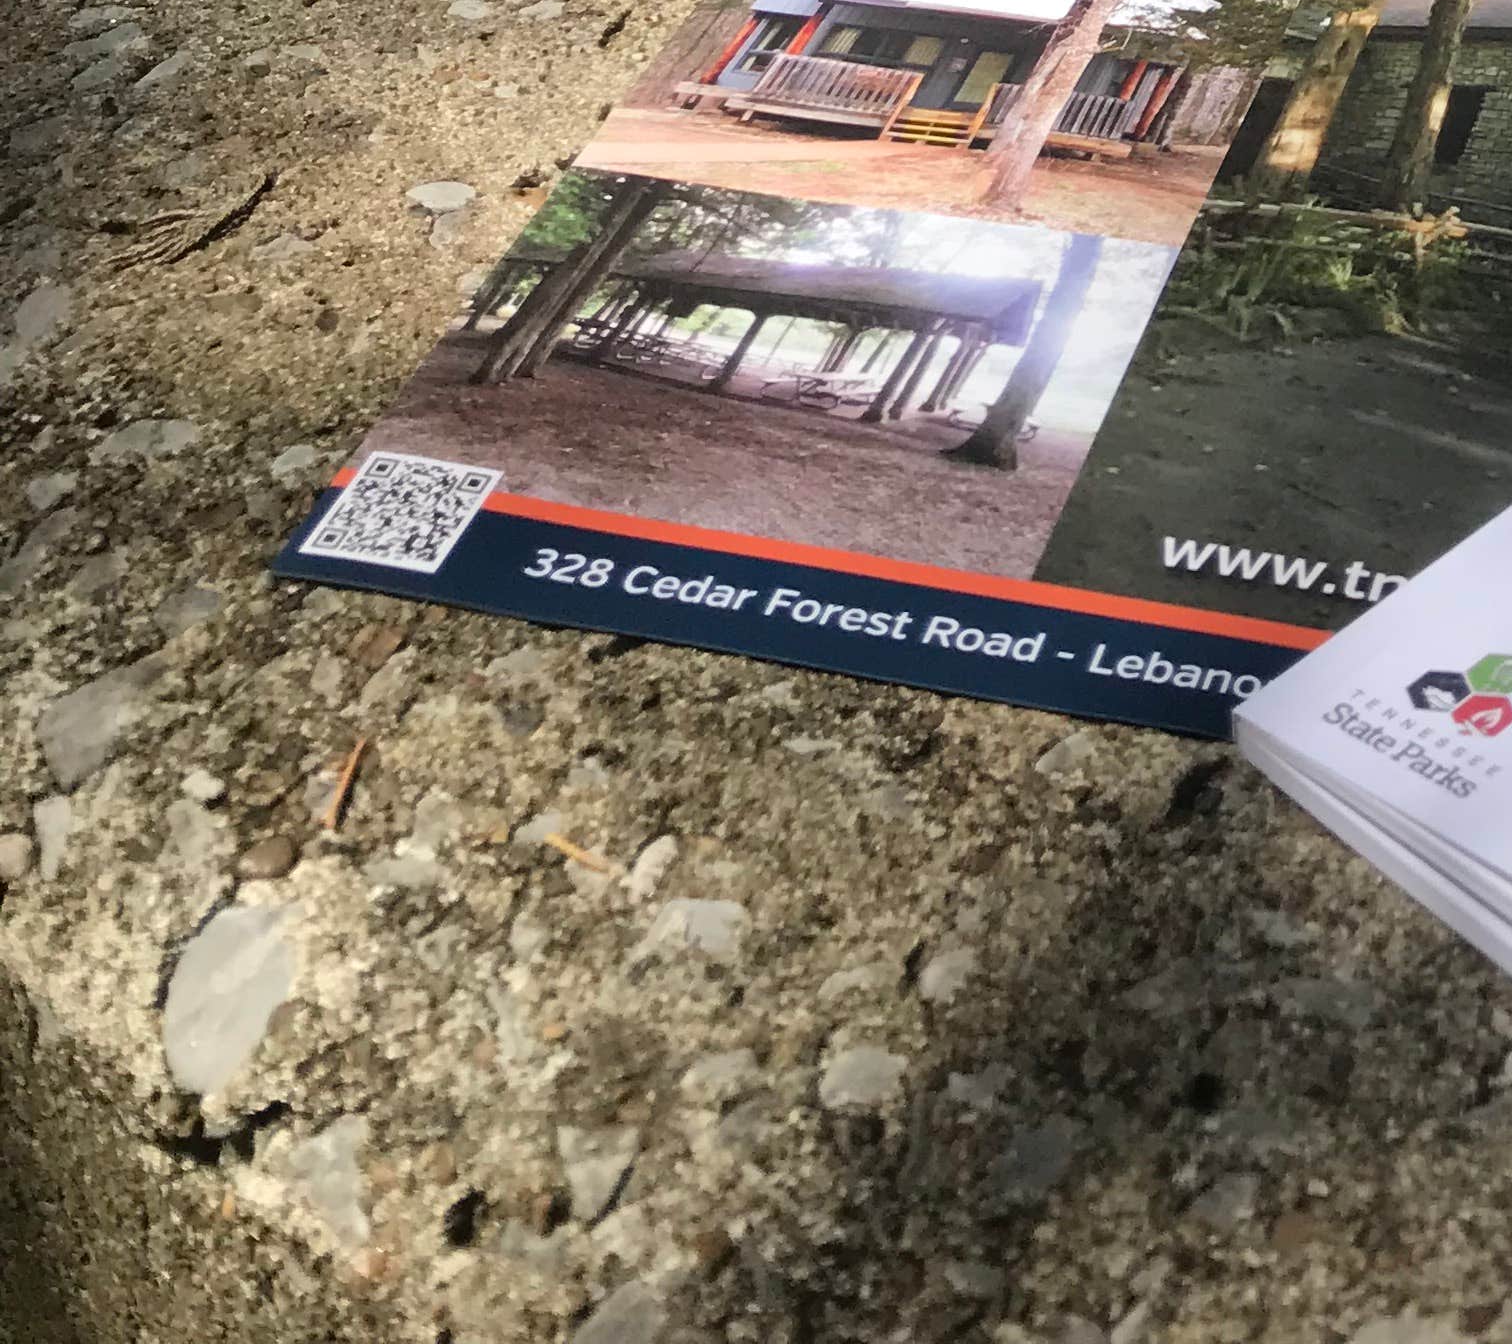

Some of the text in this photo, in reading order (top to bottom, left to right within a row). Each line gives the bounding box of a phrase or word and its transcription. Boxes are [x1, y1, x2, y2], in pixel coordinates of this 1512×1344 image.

[523, 548, 615, 588] 328
[623, 563, 758, 613] Cedar
[764, 586, 913, 642] Forest
[921, 614, 1046, 662] Road
[1087, 643, 1275, 699] Lebano
[1322, 702, 1478, 799] State Parks
[1351, 688, 1502, 777] TENNESSEE
